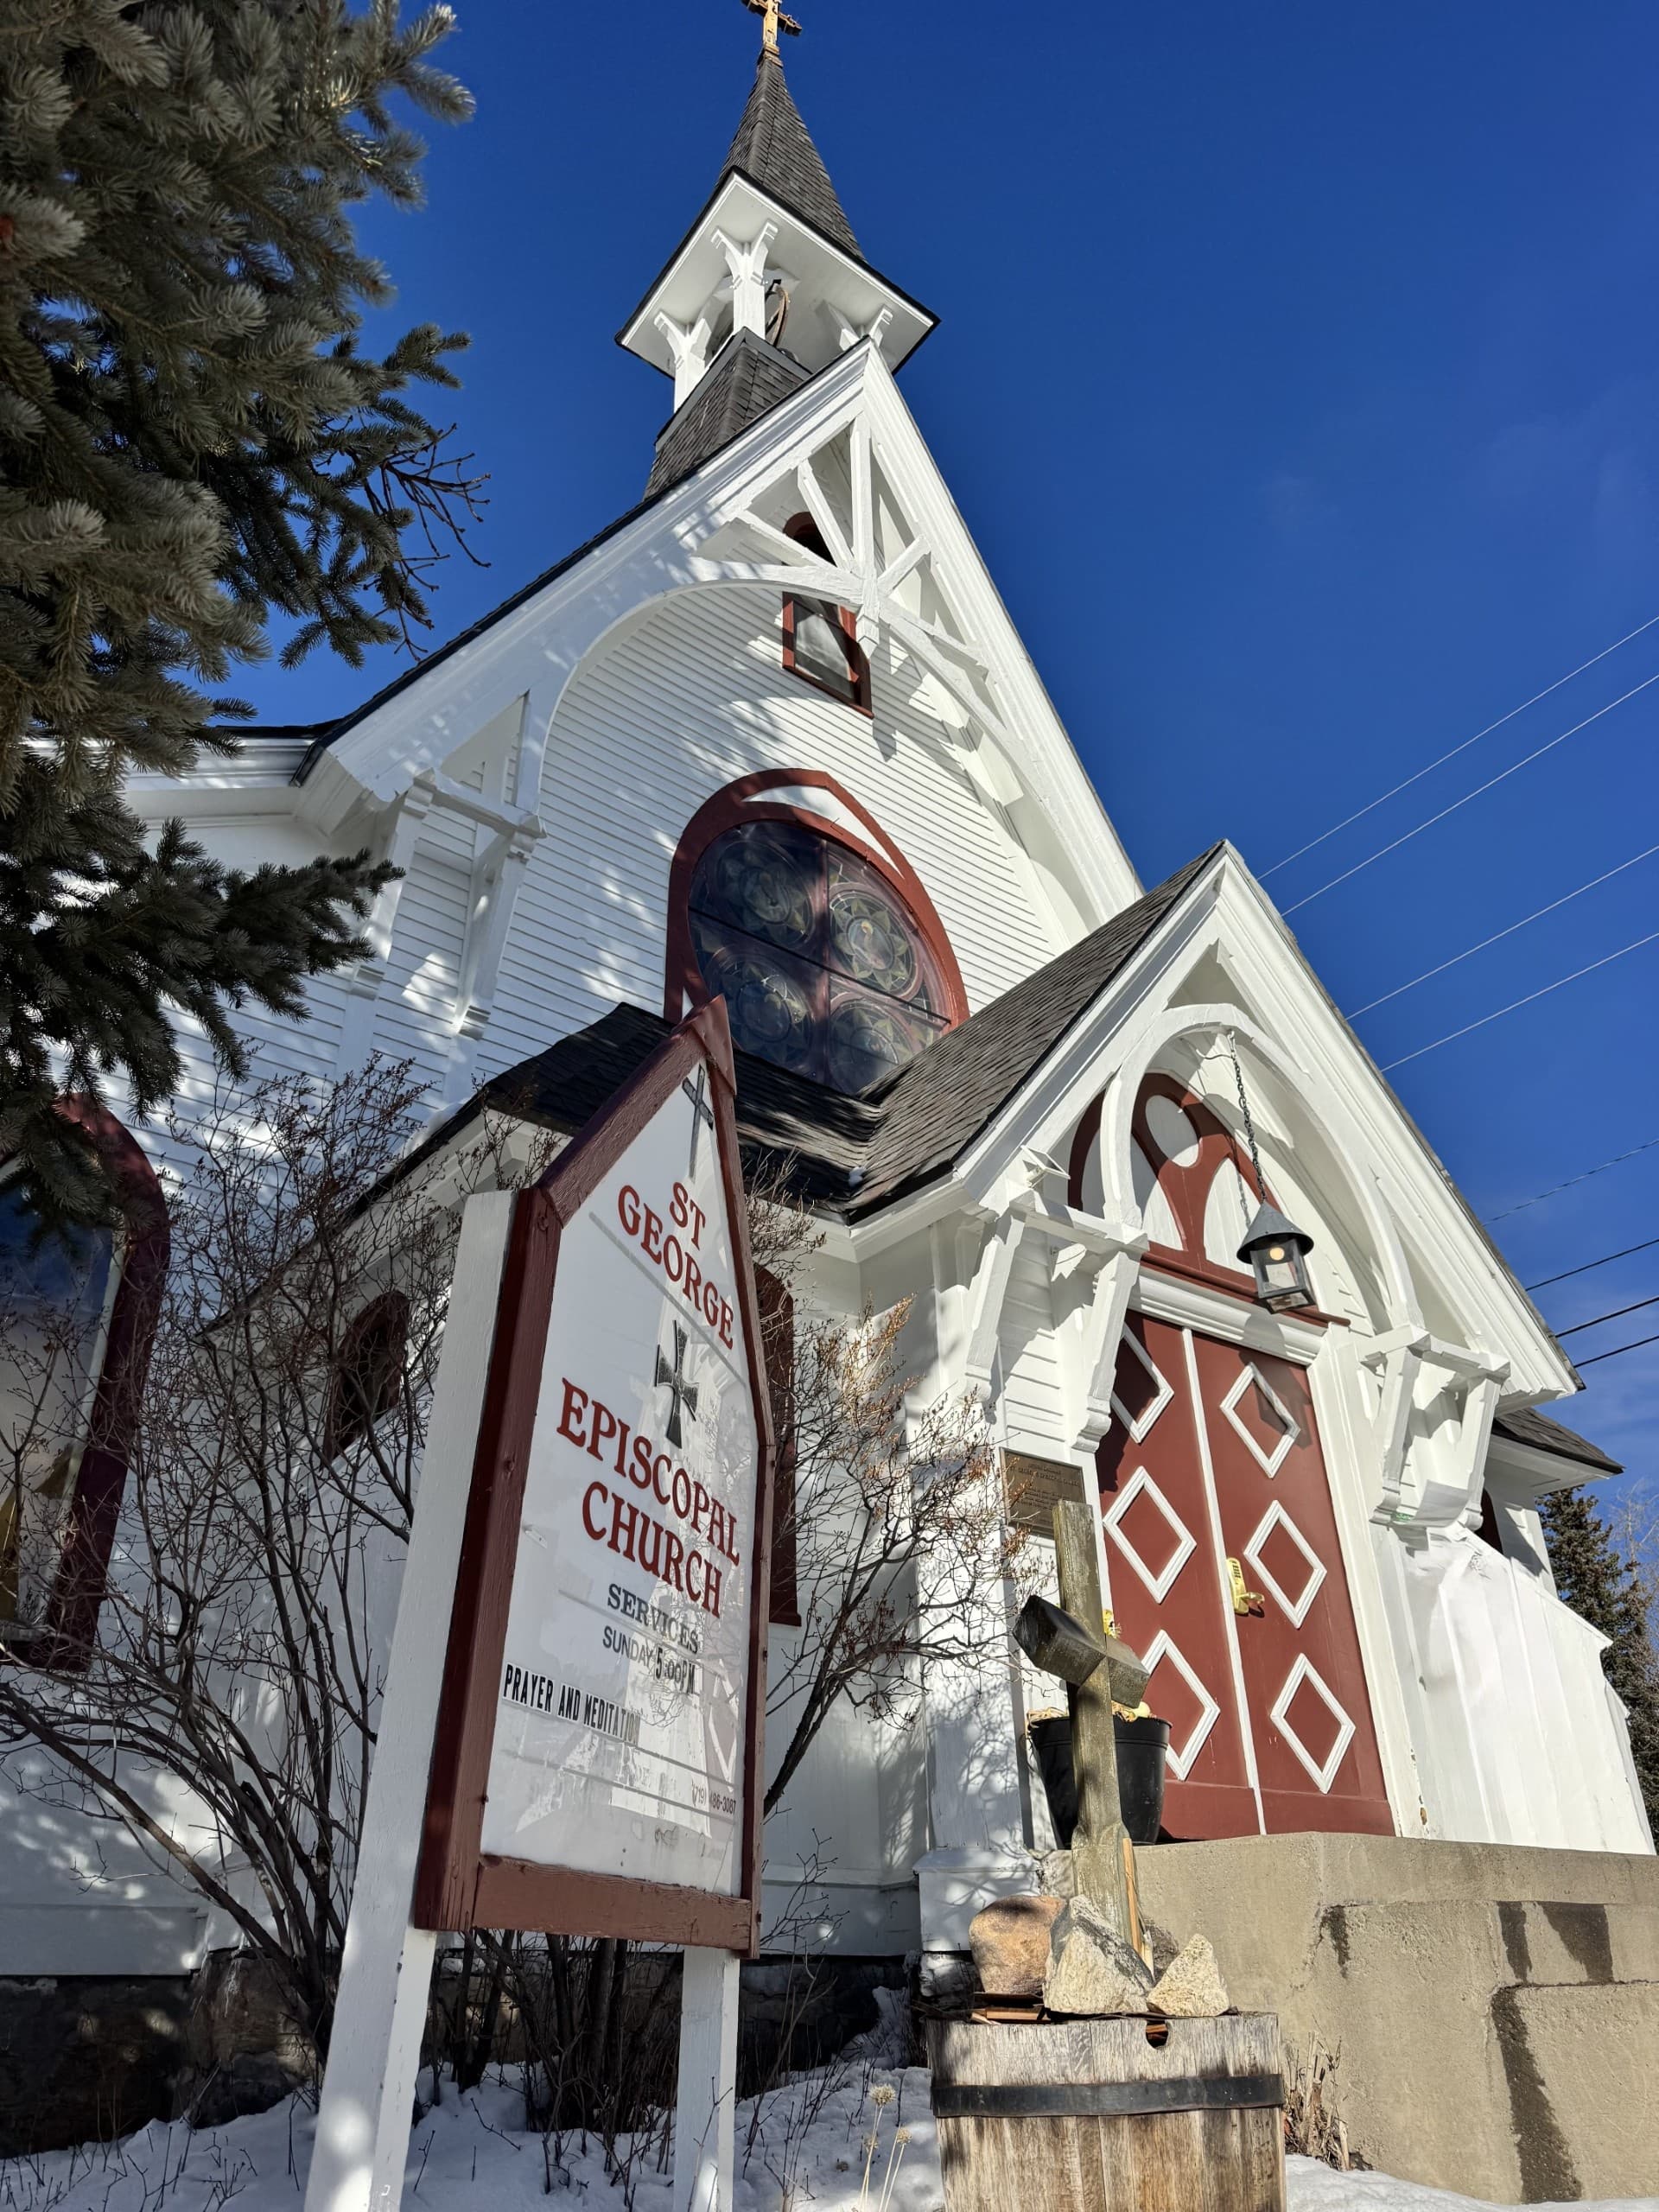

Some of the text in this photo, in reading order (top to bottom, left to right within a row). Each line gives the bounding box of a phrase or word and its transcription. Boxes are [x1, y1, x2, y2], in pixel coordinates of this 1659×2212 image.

[670, 1182, 706, 1251] ST
[618, 1185, 734, 1350] GEORGE
[556, 1377, 740, 1567] EPISCOPAL
[582, 1481, 722, 1618] CHURCH
[602, 1625, 654, 1669] SUNDAY
[607, 1583, 699, 1655] SERVICES
[504, 1663, 640, 1745] PRAYER AND MEDITATION
